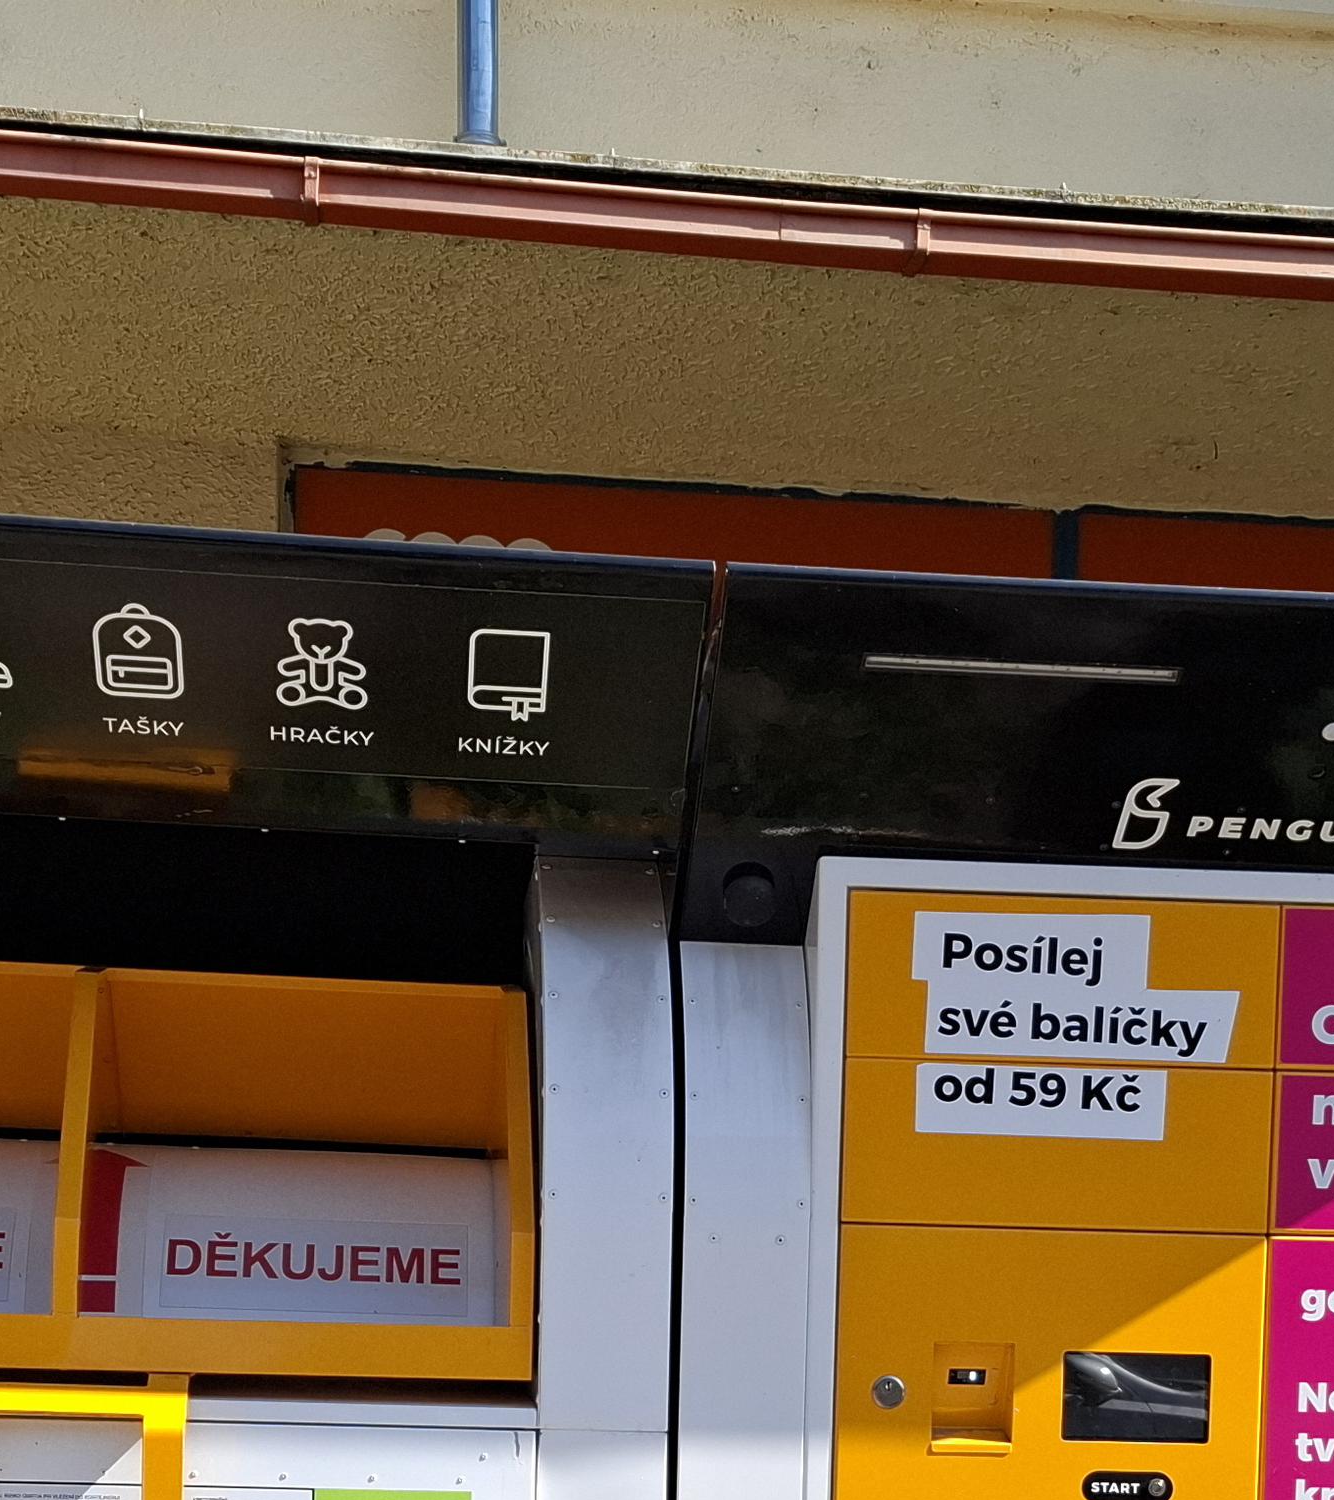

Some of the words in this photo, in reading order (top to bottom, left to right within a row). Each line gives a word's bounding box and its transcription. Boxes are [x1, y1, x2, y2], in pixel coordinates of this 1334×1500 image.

[103, 713, 184, 739] TAŠKY
[269, 722, 375, 748] HRAČKY
[457, 733, 550, 758] KNÍŽKY
[941, 932, 1105, 982] Posílej
[938, 1003, 1017, 1040] své
[1030, 1000, 1207, 1058] balíčky
[934, 1069, 996, 1106] od
[1009, 1072, 1066, 1108] 59
[1080, 1071, 1142, 1112] Kč
[165, 1230, 462, 1286] DĚKUJEME
[1091, 1481, 1140, 1494] START
